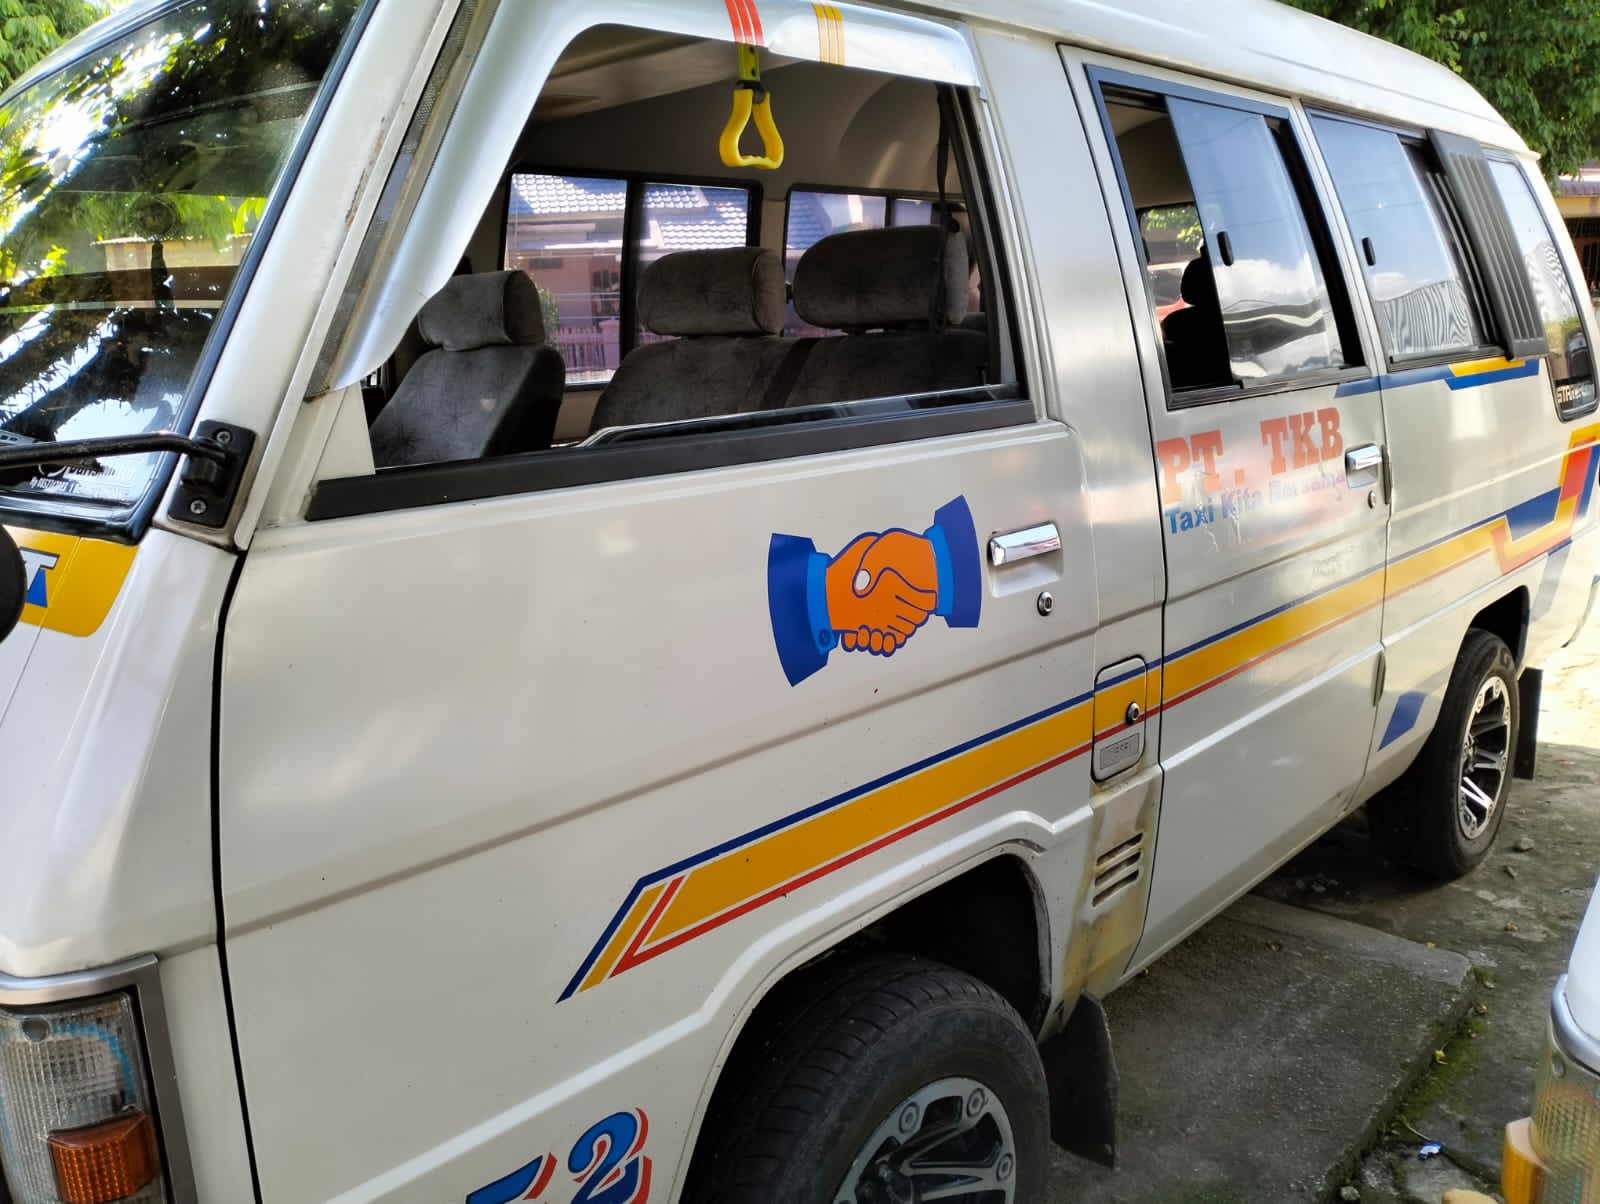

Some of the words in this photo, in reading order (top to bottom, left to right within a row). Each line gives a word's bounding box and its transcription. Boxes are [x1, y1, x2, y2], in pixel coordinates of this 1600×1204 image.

[1260, 407, 1343, 475] TKB
[1165, 498, 1215, 534] Taxi
[1221, 487, 1263, 519] Kita
